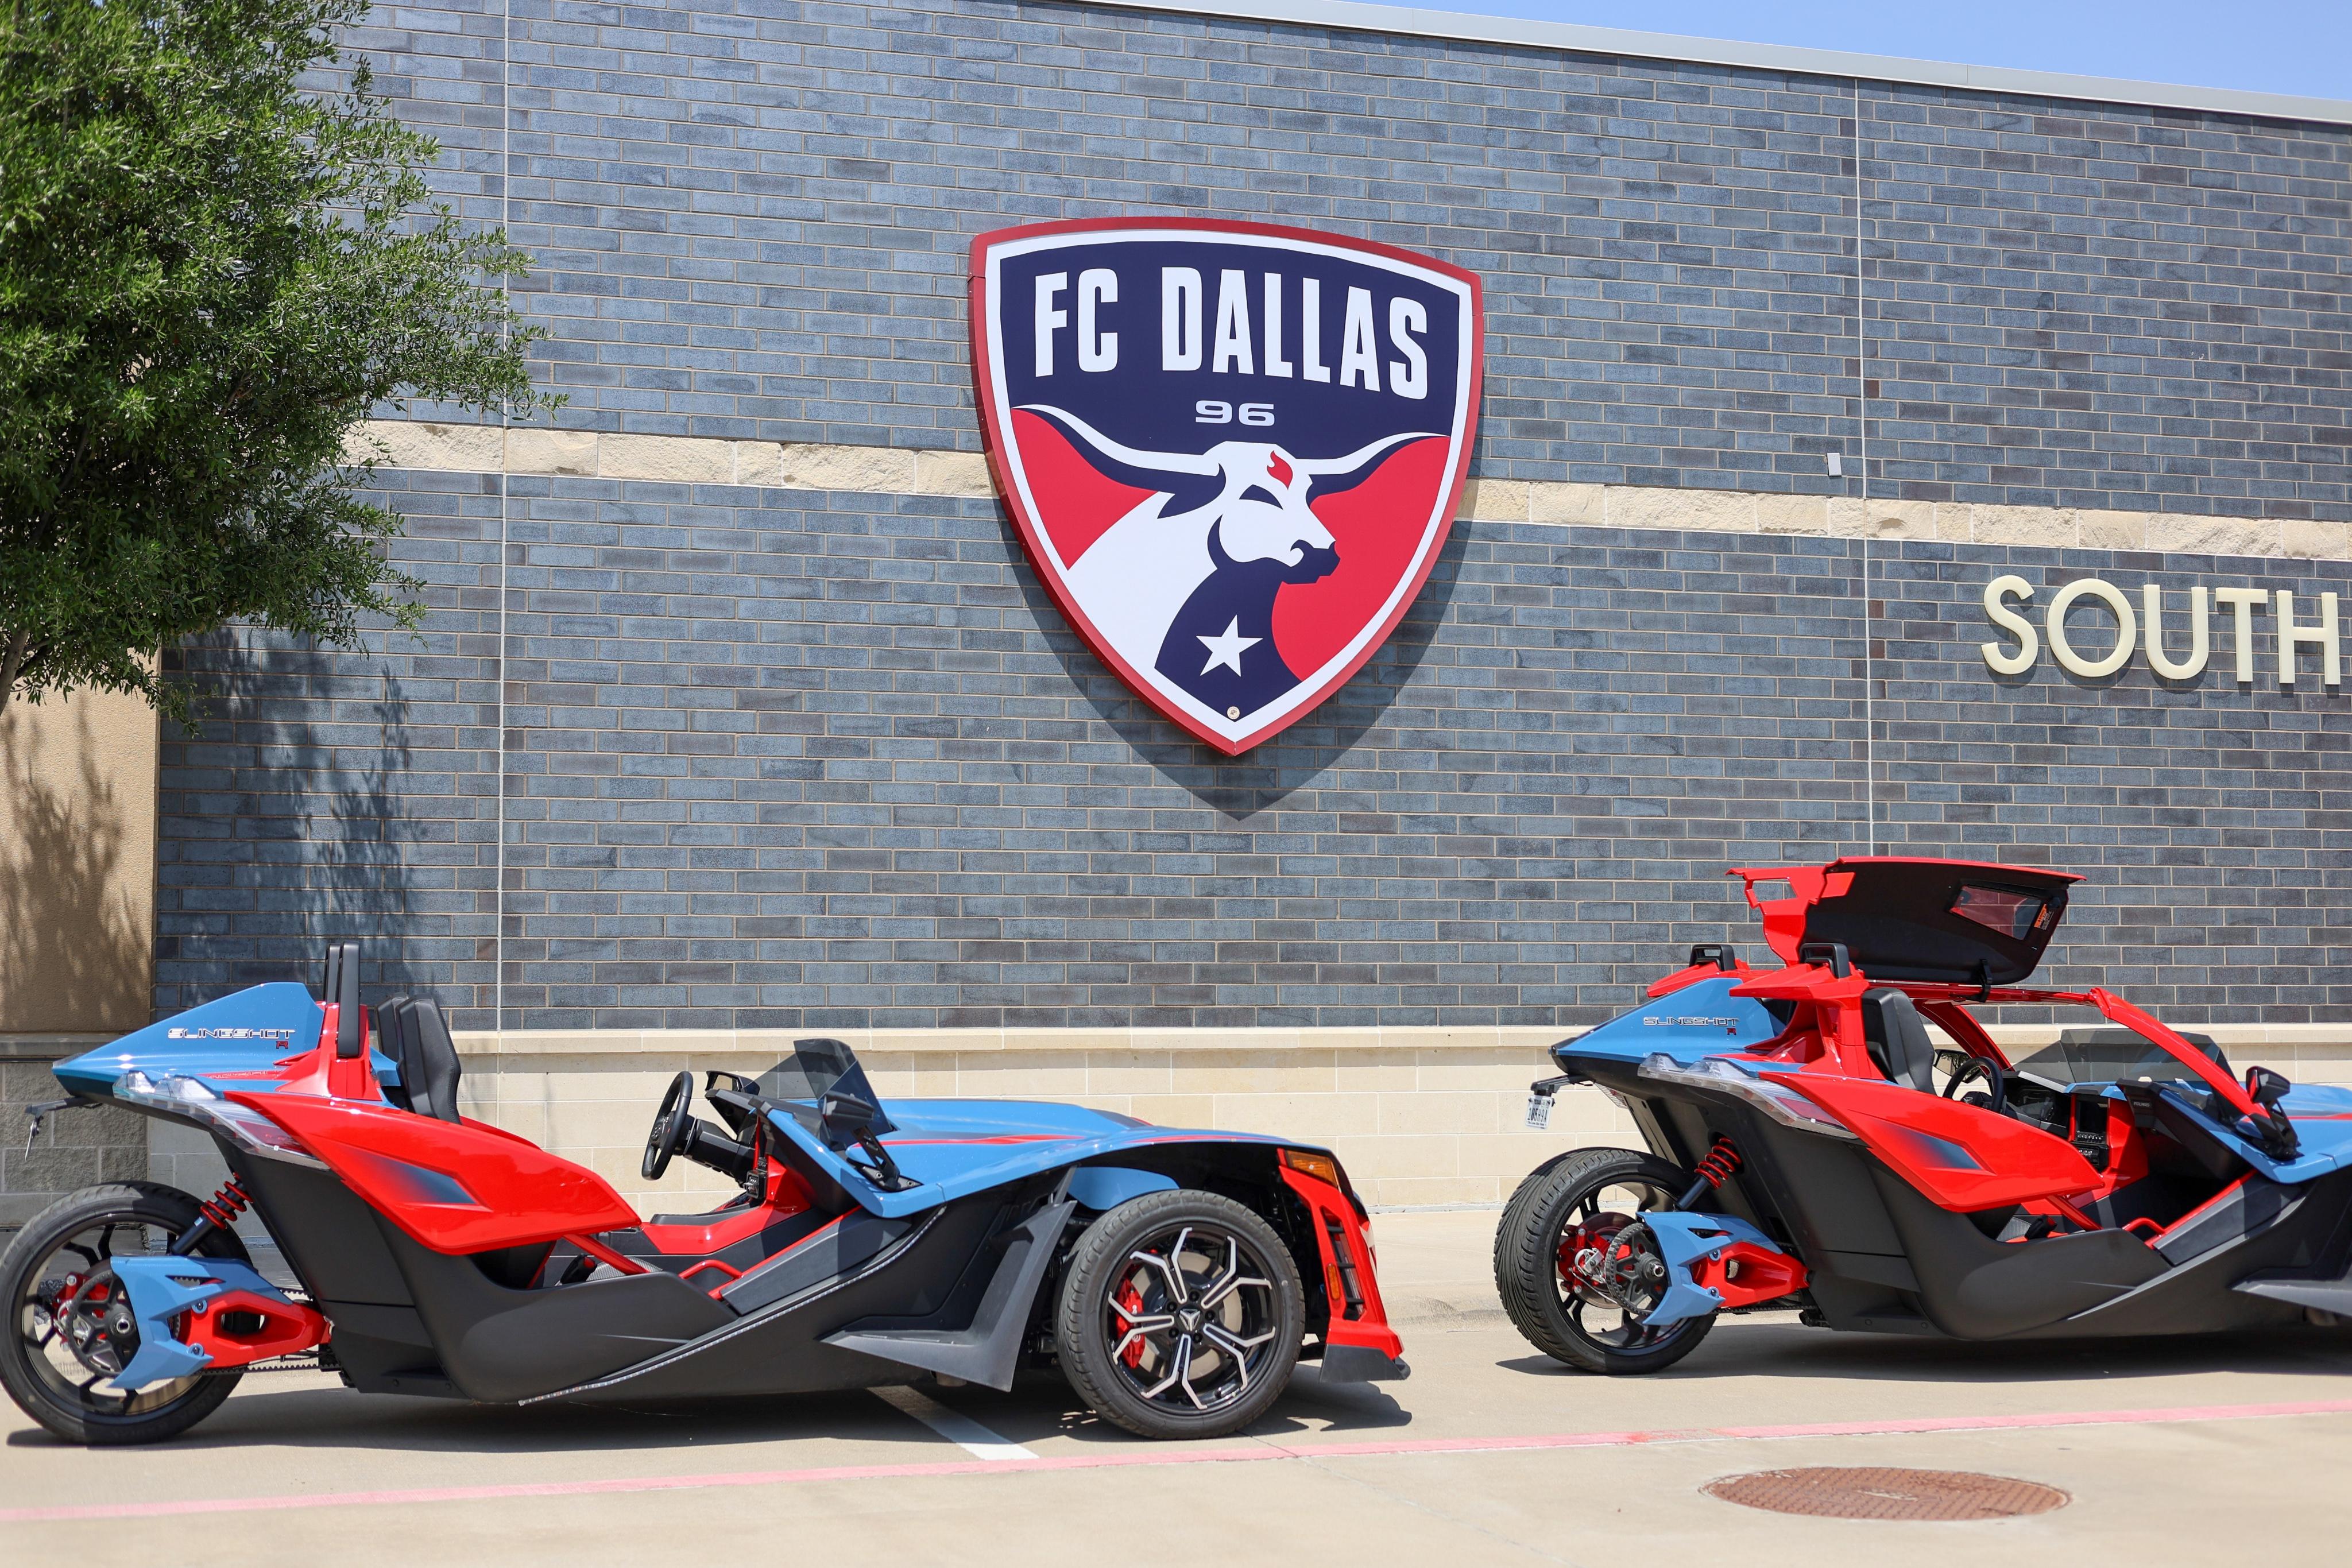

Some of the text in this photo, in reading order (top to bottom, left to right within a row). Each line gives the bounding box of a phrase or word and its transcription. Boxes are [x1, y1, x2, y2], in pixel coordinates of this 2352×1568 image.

[1035, 267, 1428, 400] FC DALLAS
[1196, 400, 1275, 426] 96
[1981, 575, 2341, 685] SOUTH
[1643, 1017, 1739, 1026] SLINGSHOT
[168, 1028, 295, 1039] SLINGSHOT
[276, 1040, 288, 1049] R
